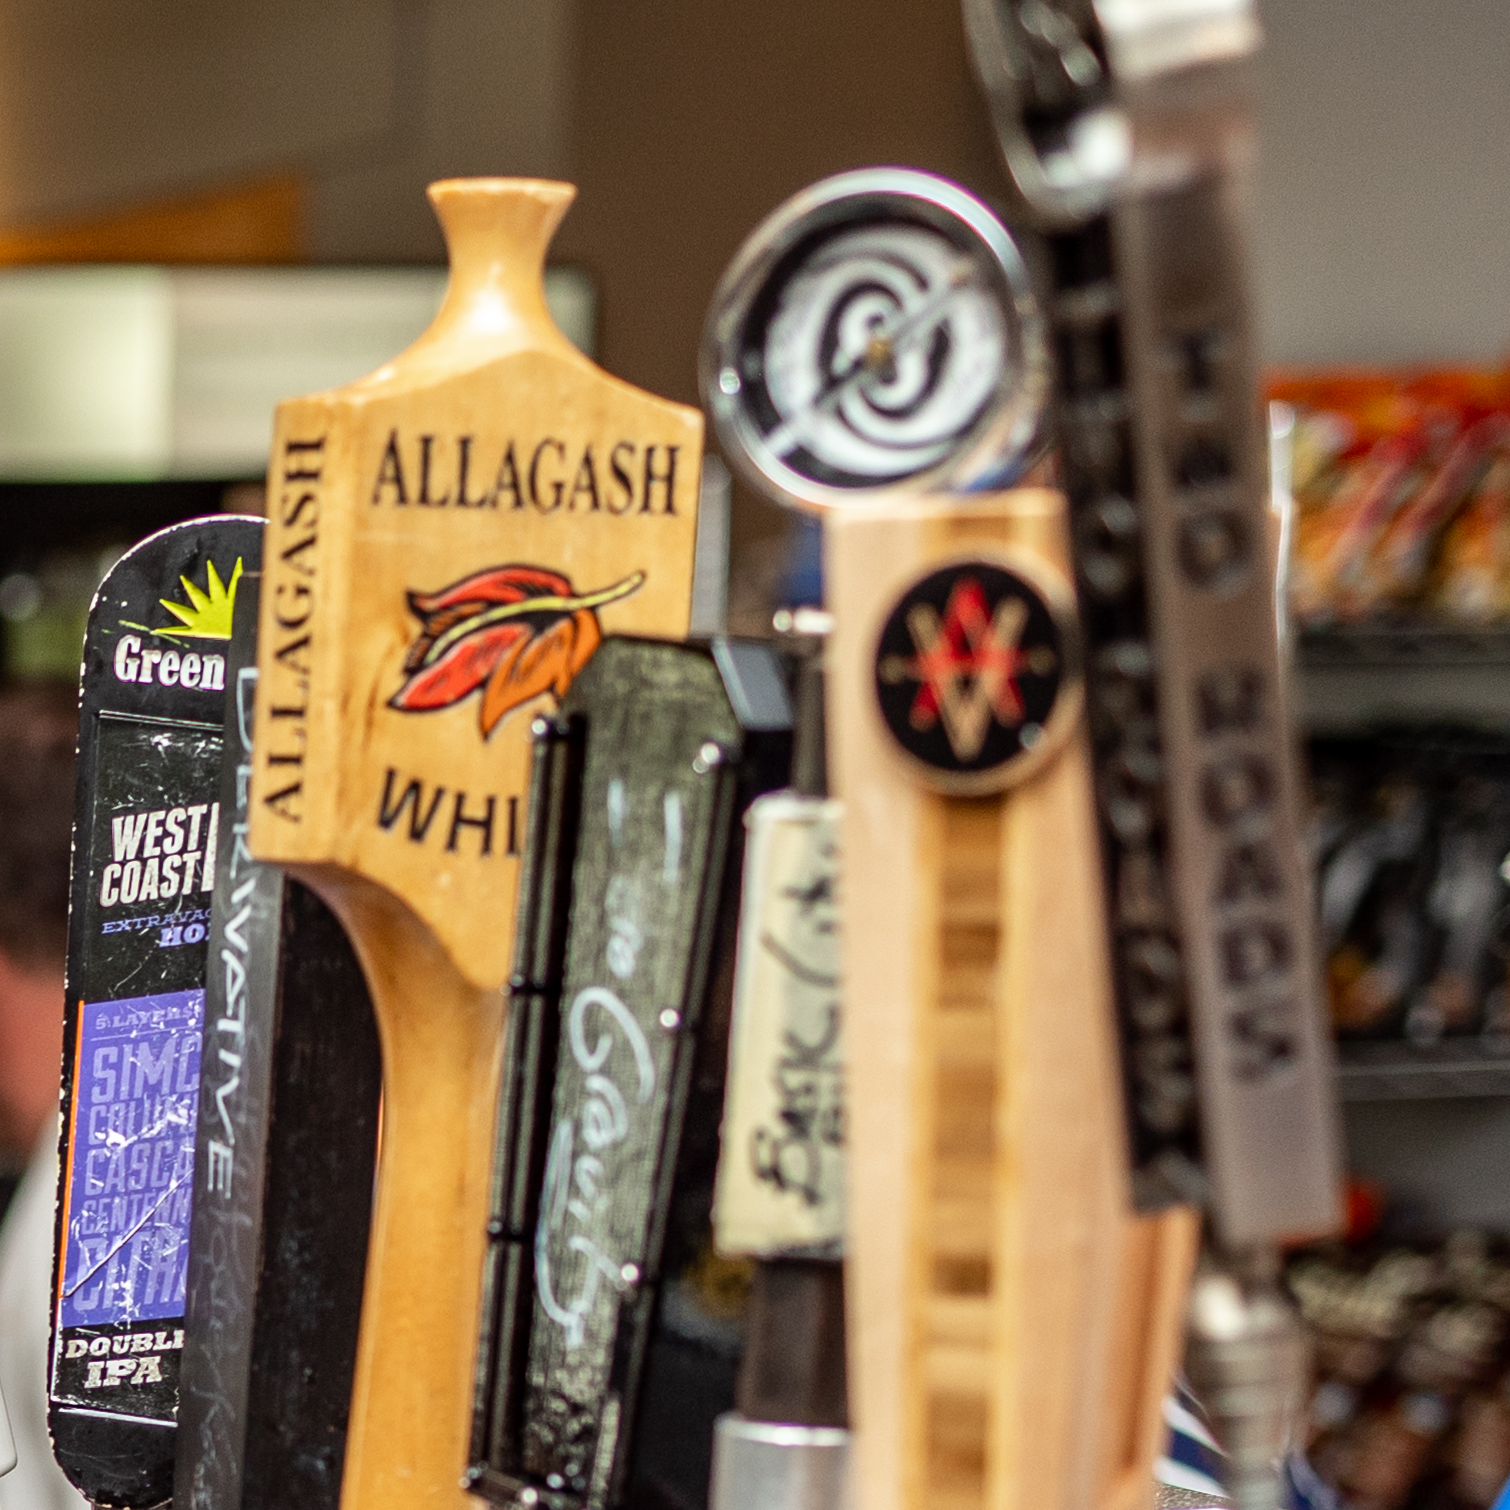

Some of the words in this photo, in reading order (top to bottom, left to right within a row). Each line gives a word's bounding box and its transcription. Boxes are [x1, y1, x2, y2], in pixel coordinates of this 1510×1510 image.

[371, 427, 682, 516] ALLAGASH
[264, 435, 326, 824] ALLAGASH
[114, 634, 225, 691] Green
[111, 803, 208, 862] WEST
[99, 850, 202, 908] COAST
[159, 921, 211, 948] HO
[84, 1356, 163, 1389] IPA
